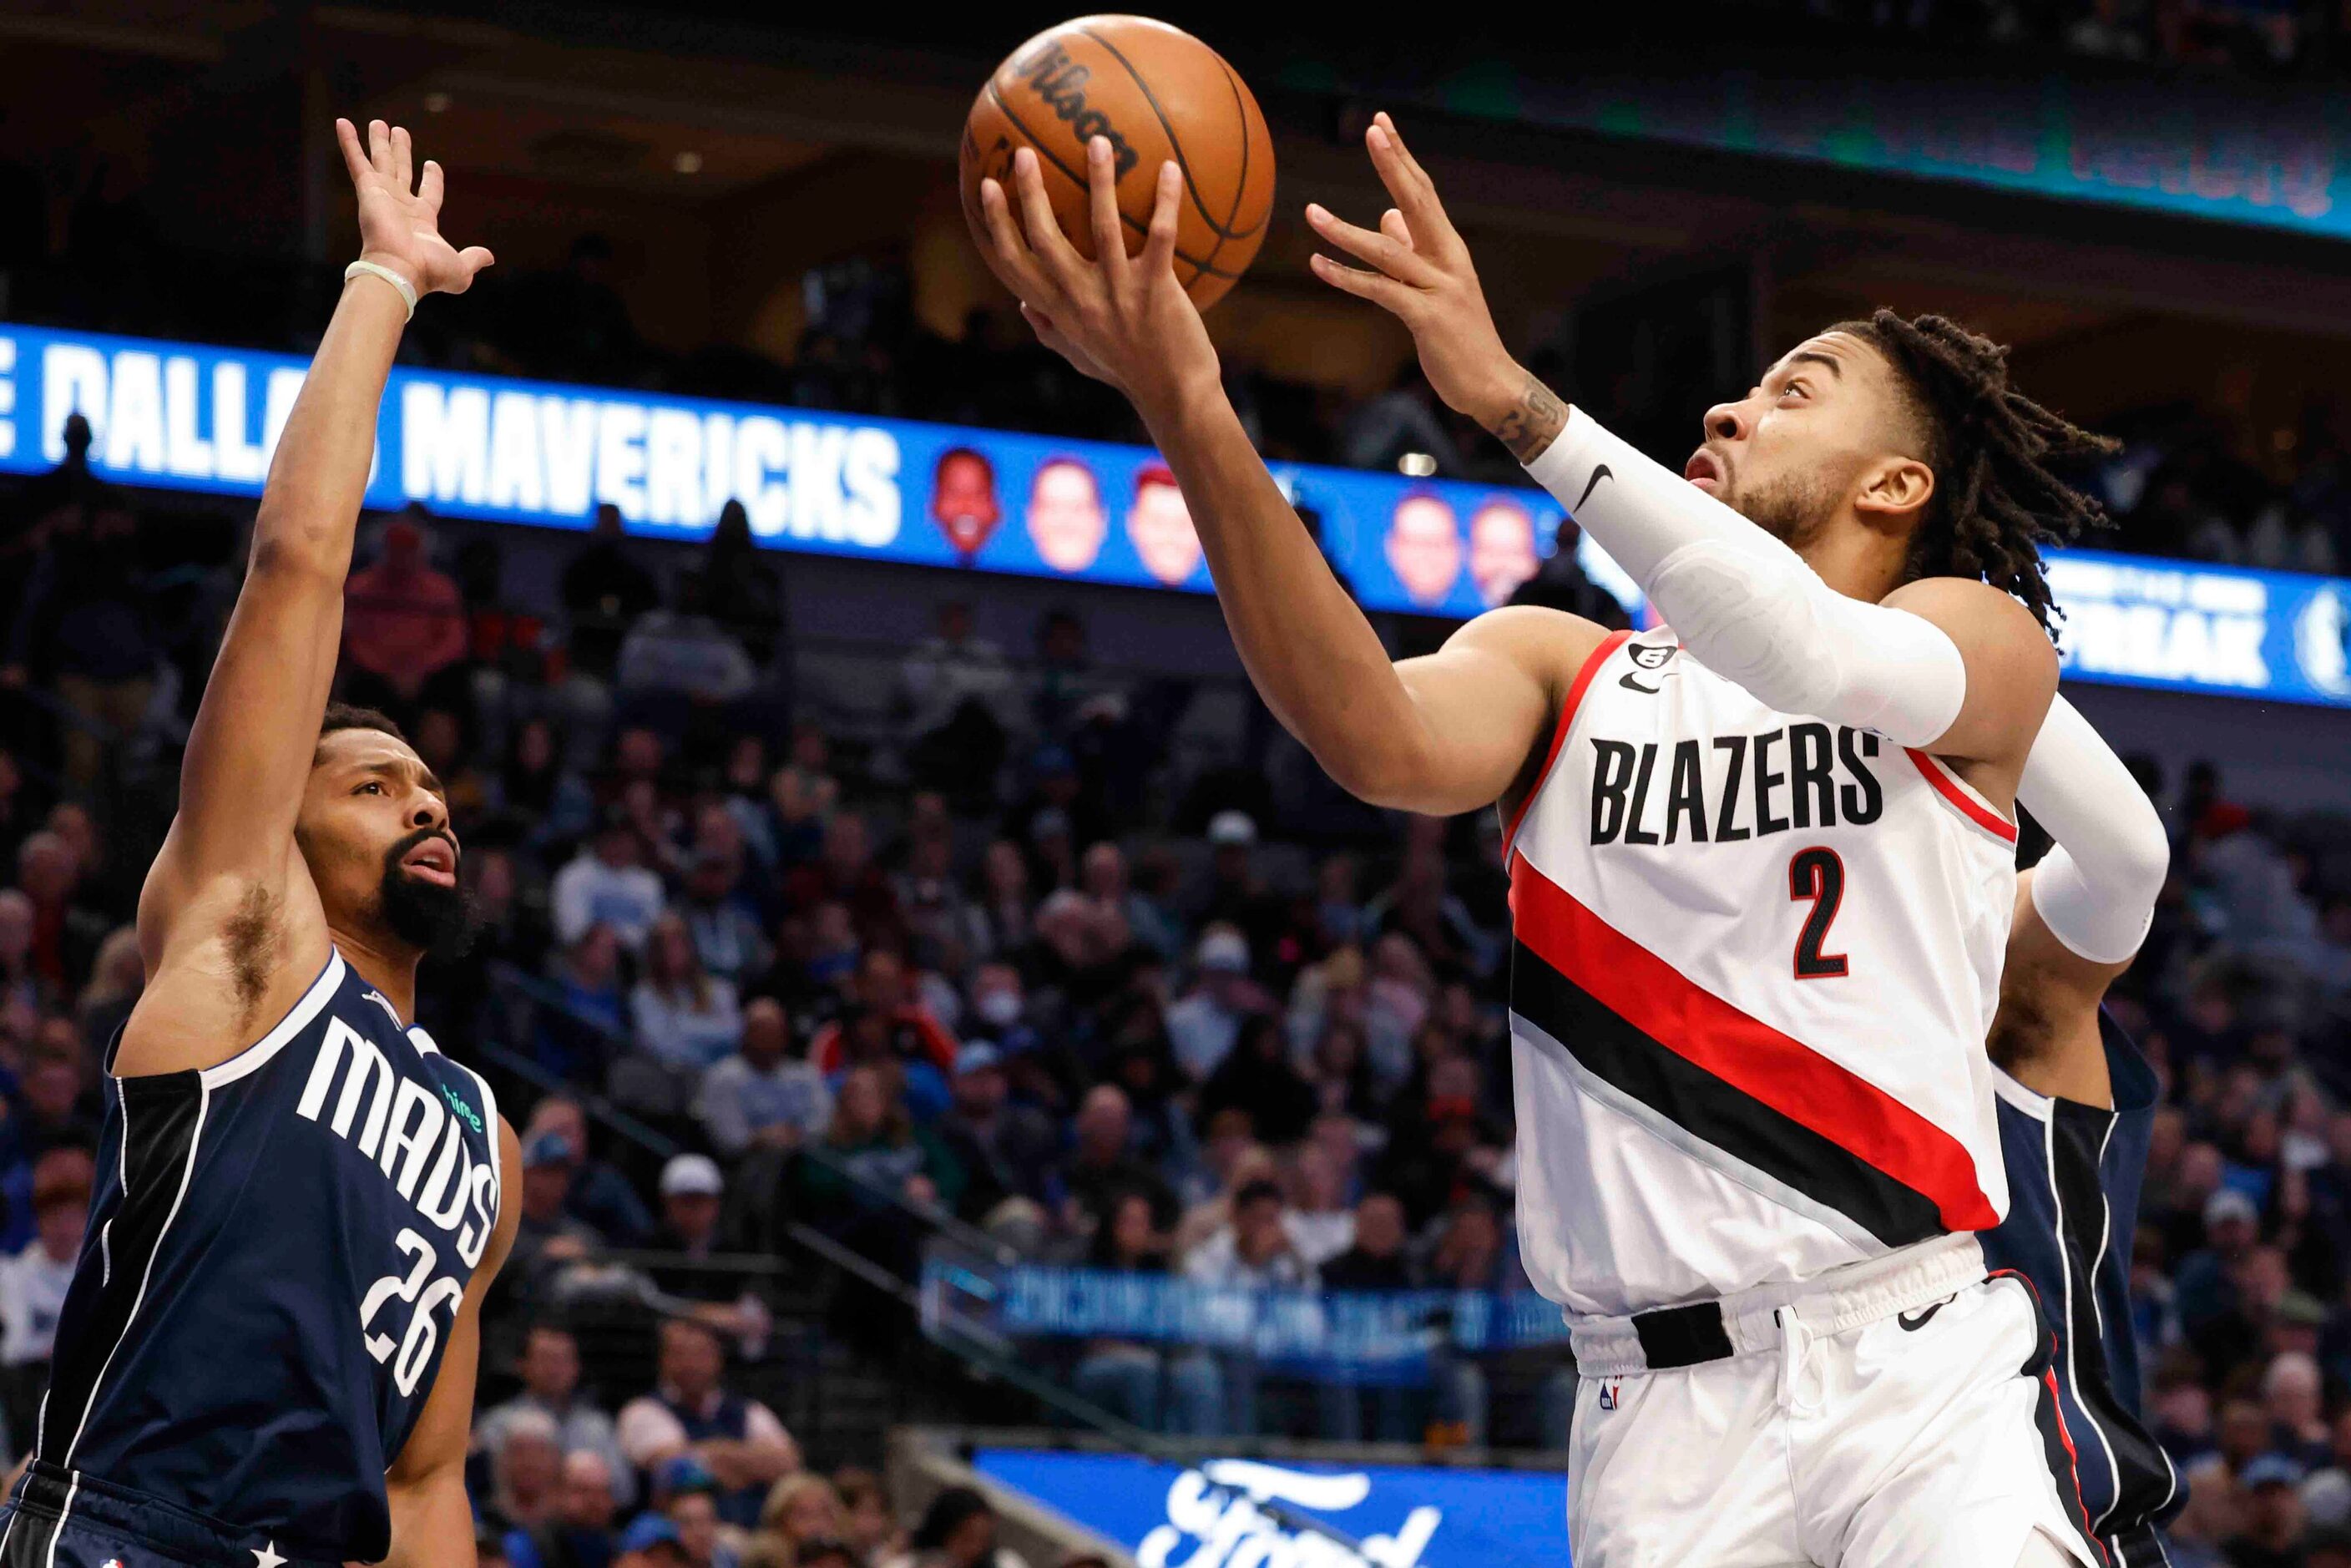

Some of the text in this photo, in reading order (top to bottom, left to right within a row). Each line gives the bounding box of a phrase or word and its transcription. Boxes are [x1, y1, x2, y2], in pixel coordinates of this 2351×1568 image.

[43, 344, 378, 489] DALL
[402, 382, 902, 548] MAVERICKS
[1590, 722, 1883, 847] BLAZERS
[1789, 846, 1849, 980] 2
[296, 1015, 495, 1268] MAVS
[442, 1083, 482, 1133] hime
[360, 1227, 464, 1398] 26
